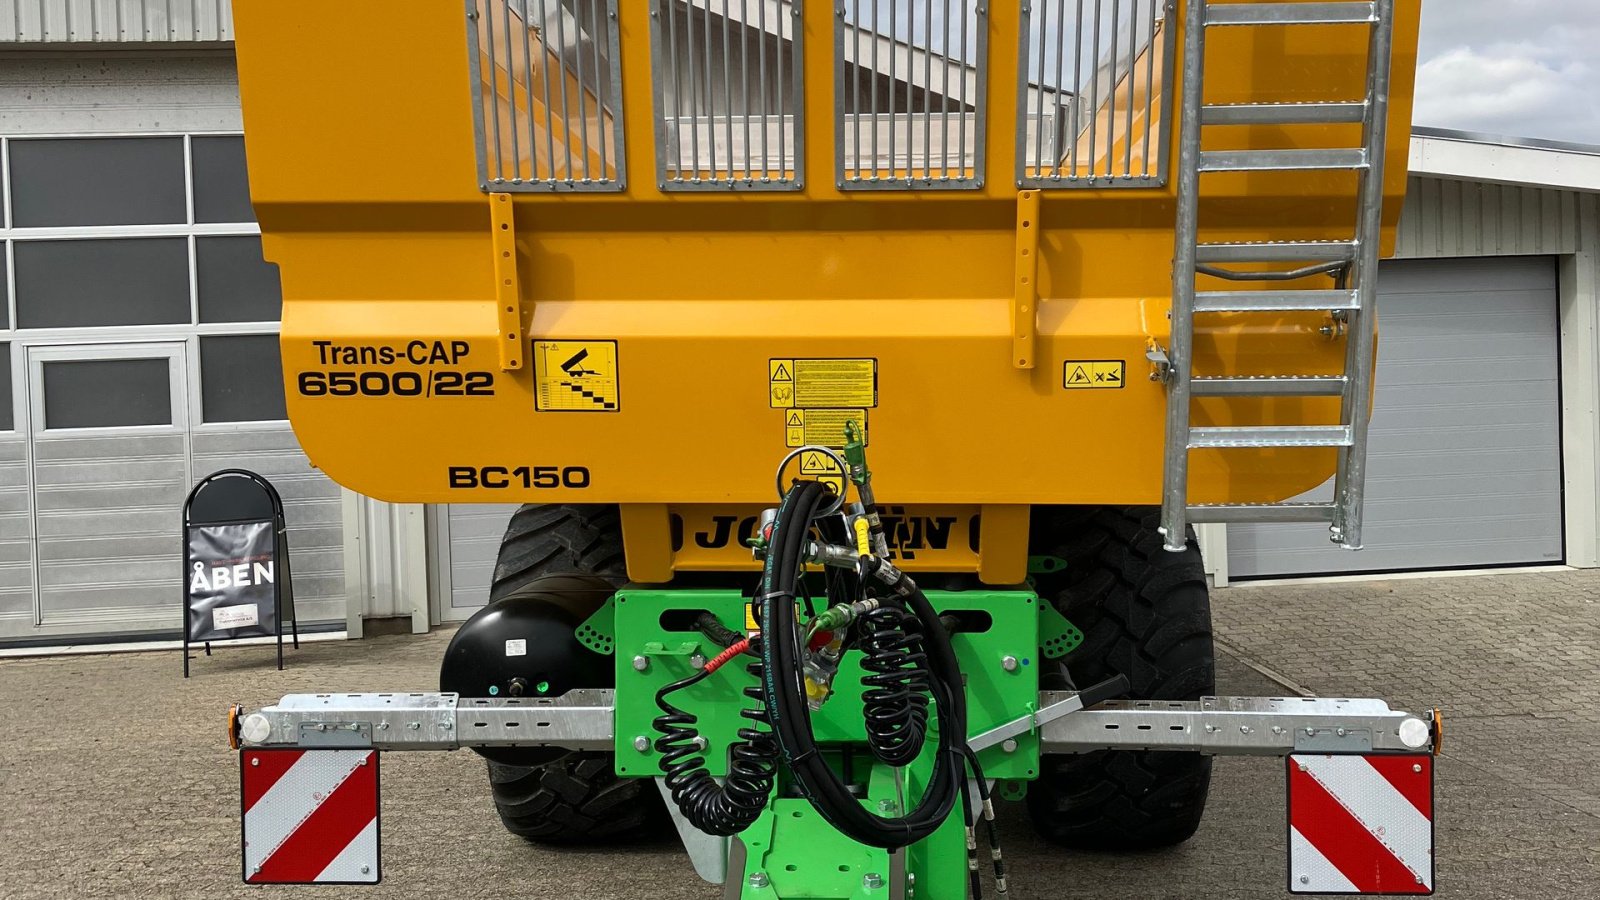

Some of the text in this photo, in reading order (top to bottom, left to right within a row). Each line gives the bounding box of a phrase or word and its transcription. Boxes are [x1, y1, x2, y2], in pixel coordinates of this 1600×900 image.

[312, 340, 470, 365] Trans-CAP
[298, 369, 495, 398] 6500/22
[448, 466, 591, 489] BC150
[190, 561, 274, 594] ÅBEN
